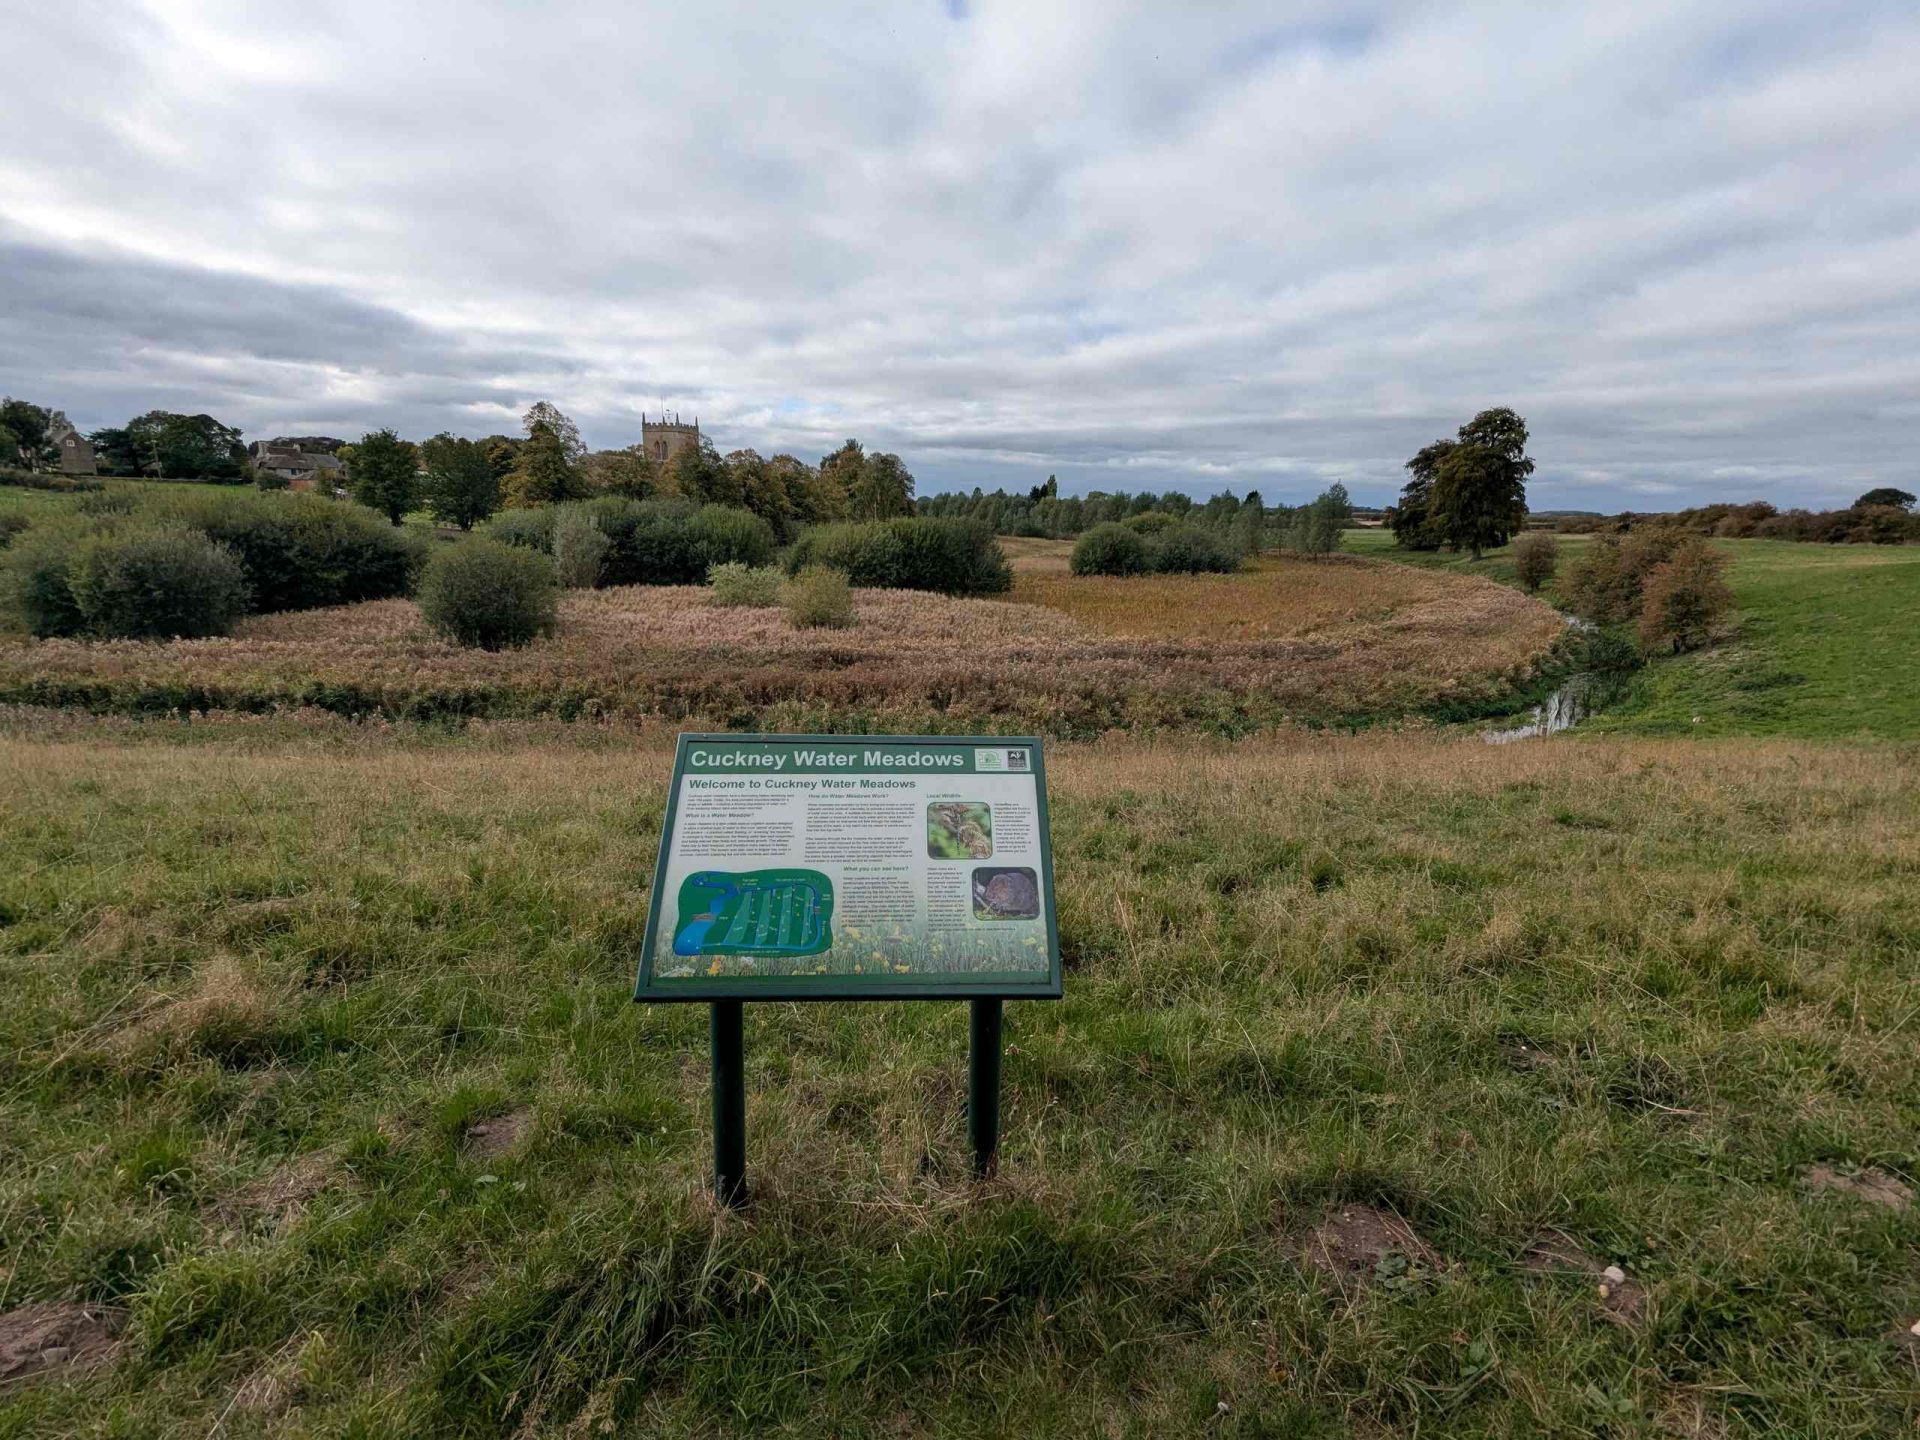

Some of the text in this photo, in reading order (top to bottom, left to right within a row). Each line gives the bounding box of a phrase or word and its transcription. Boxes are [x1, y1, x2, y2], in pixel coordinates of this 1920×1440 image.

[691, 750, 787, 770] Cuckney
[794, 750, 857, 767] Water
[864, 750, 964, 767] Meadows
[689, 779, 916, 791] Welcome to Cuckney Water Meadows
